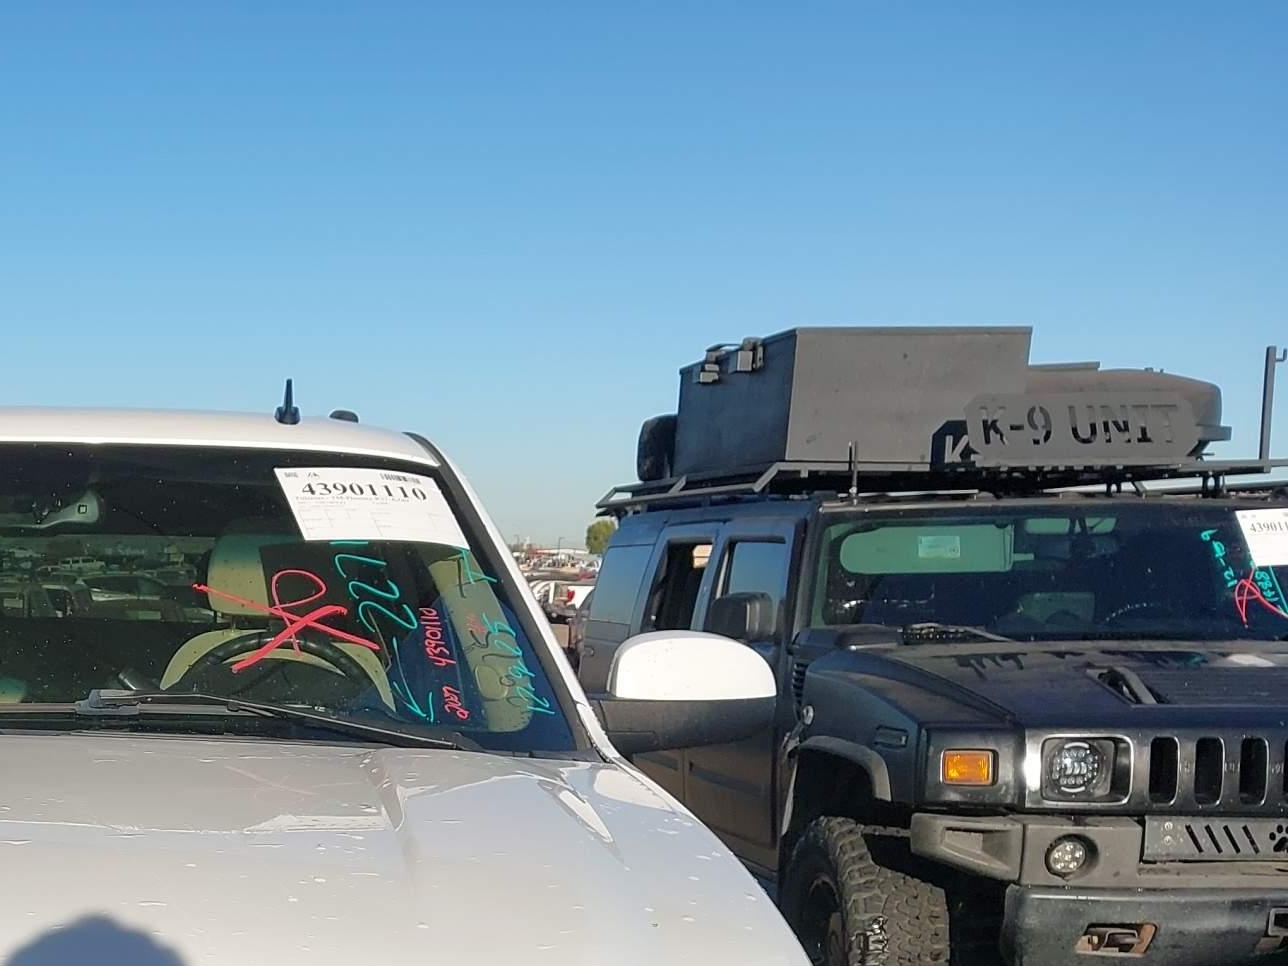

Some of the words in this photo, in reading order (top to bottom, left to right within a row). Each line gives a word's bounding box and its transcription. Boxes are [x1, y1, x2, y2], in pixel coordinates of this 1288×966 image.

[979, 405, 1053, 445] K-9
[1068, 404, 1177, 444] UNIT
[302, 481, 427, 501] 43901110
[418, 607, 457, 666] 43901110
